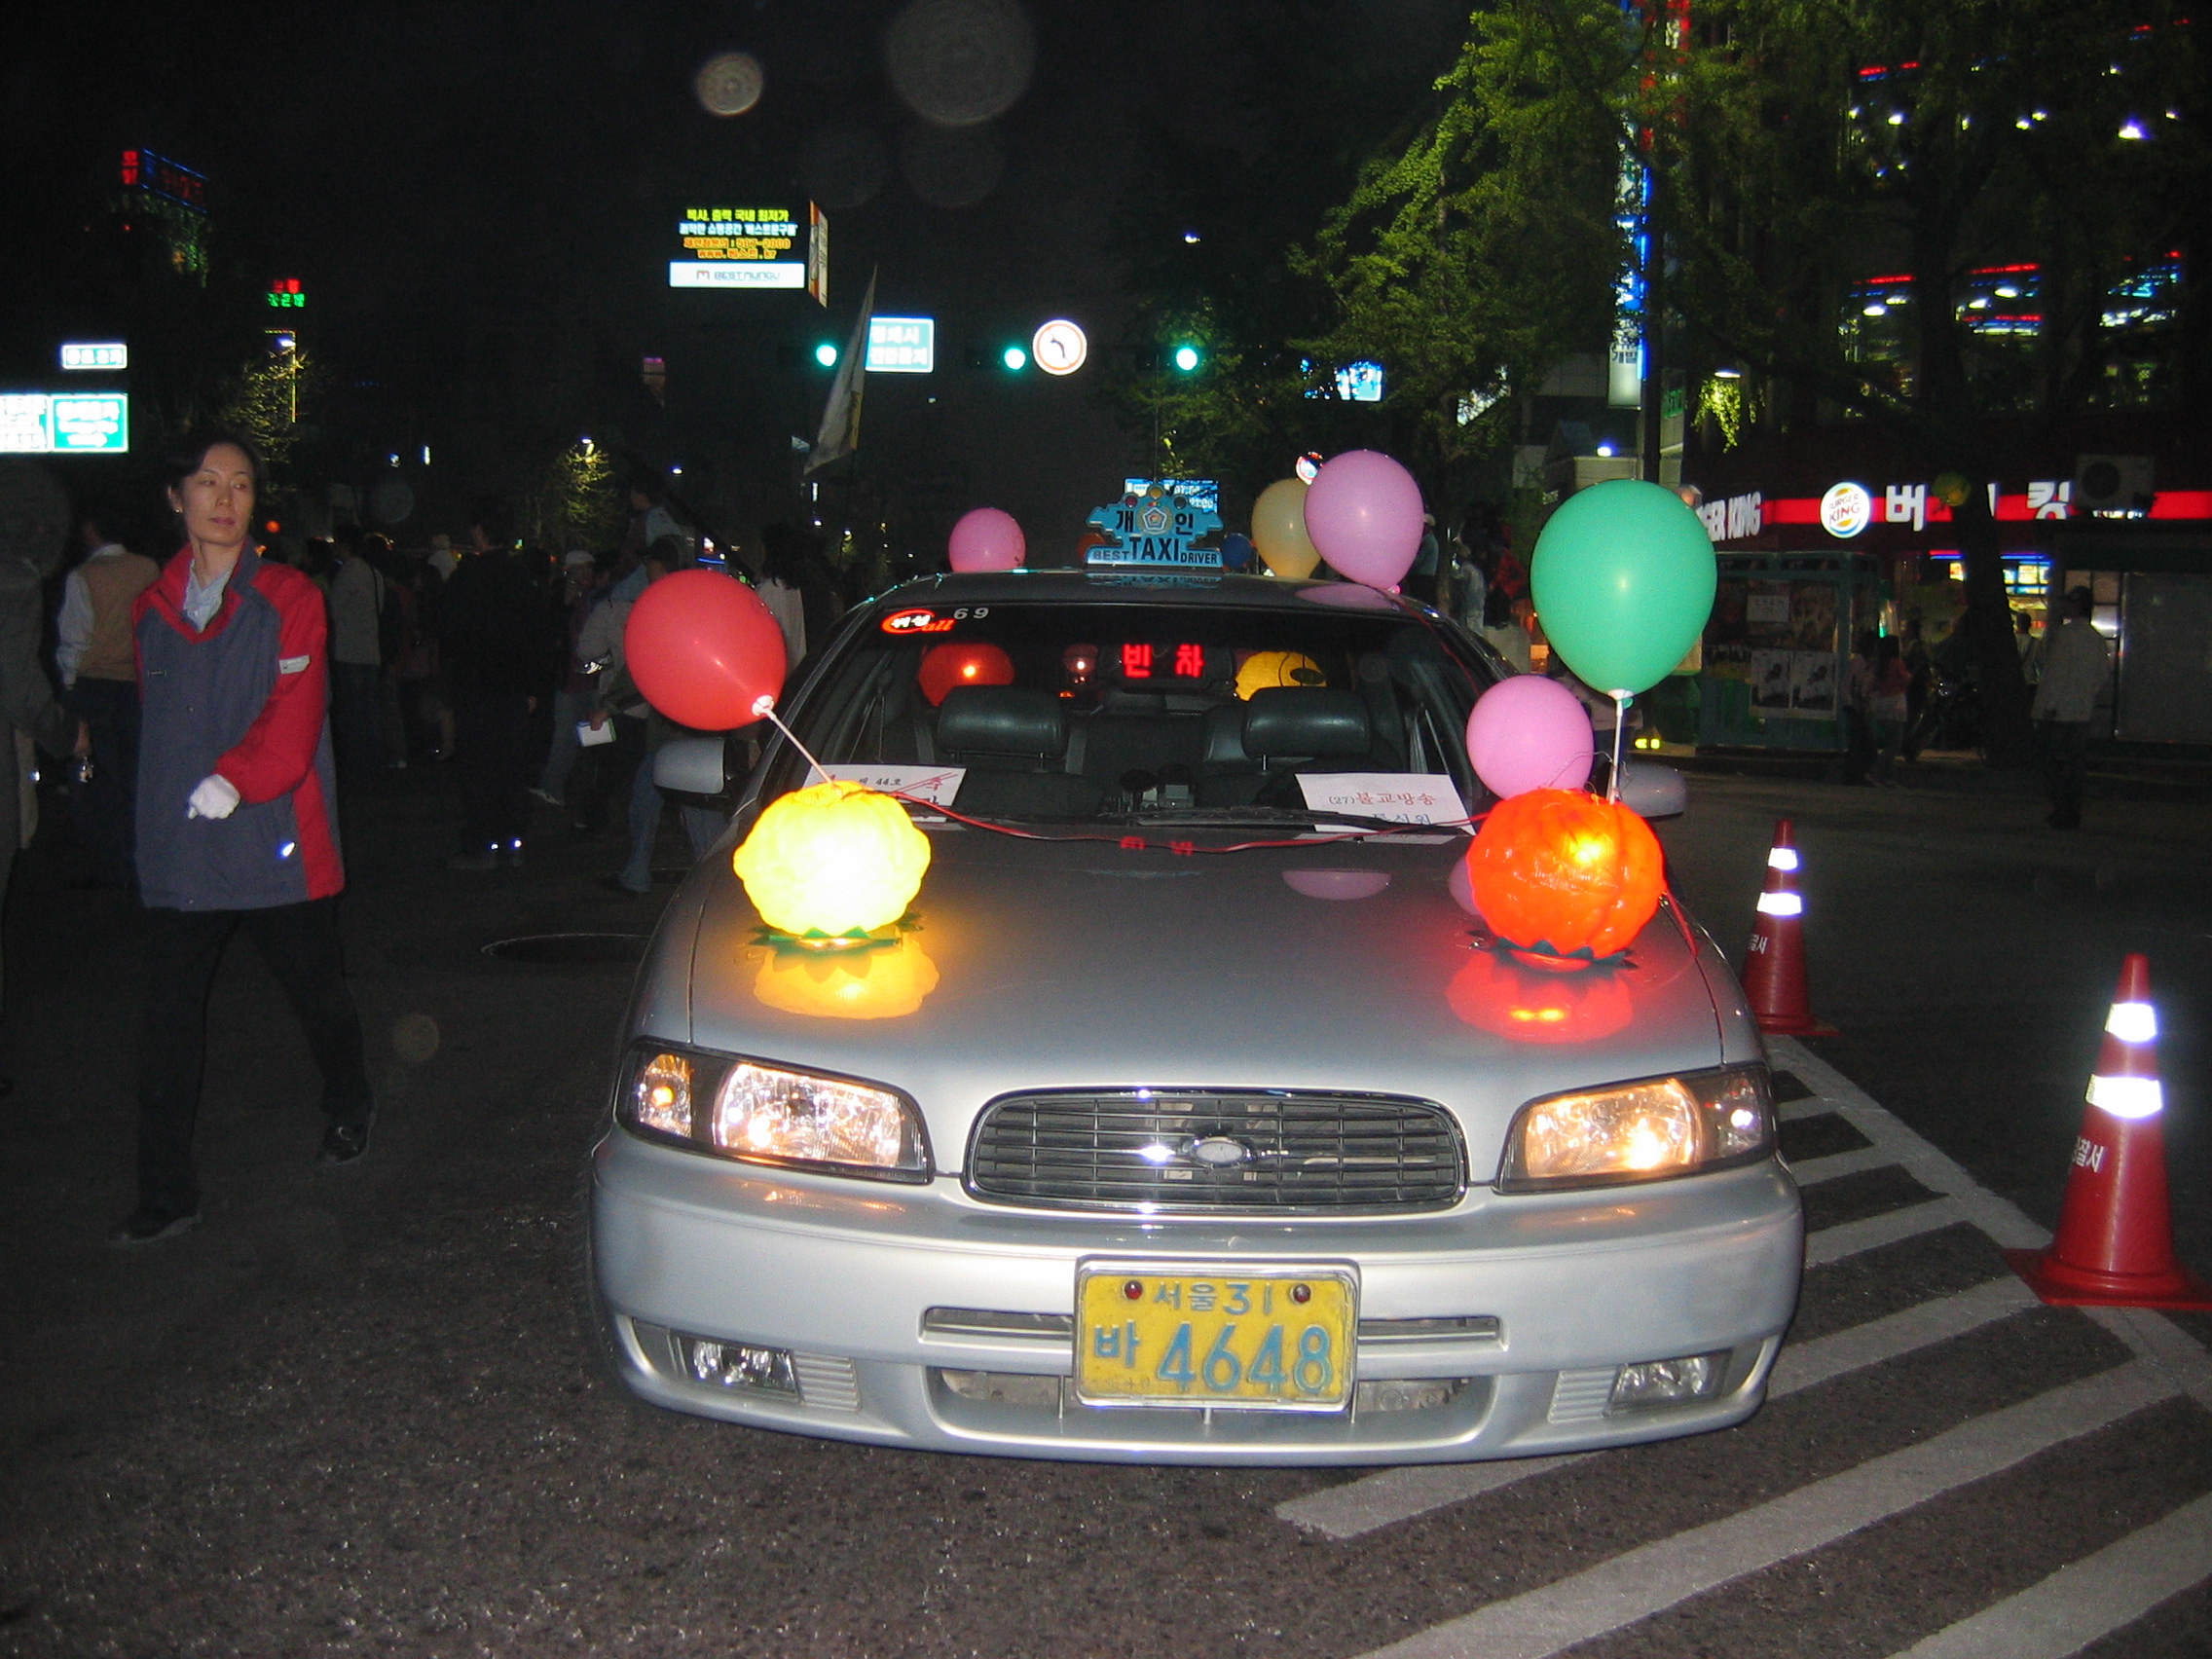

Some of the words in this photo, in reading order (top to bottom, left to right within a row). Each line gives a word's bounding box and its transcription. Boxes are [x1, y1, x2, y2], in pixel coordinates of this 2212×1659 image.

[1727, 491, 1761, 539] KING
[1828, 502, 1861, 526] KING
[1093, 549, 1130, 561] BEST
[1128, 536, 1179, 562] TAXI
[1093, 1318, 1141, 1368] 바
[1156, 1320, 1333, 1394] 4648
